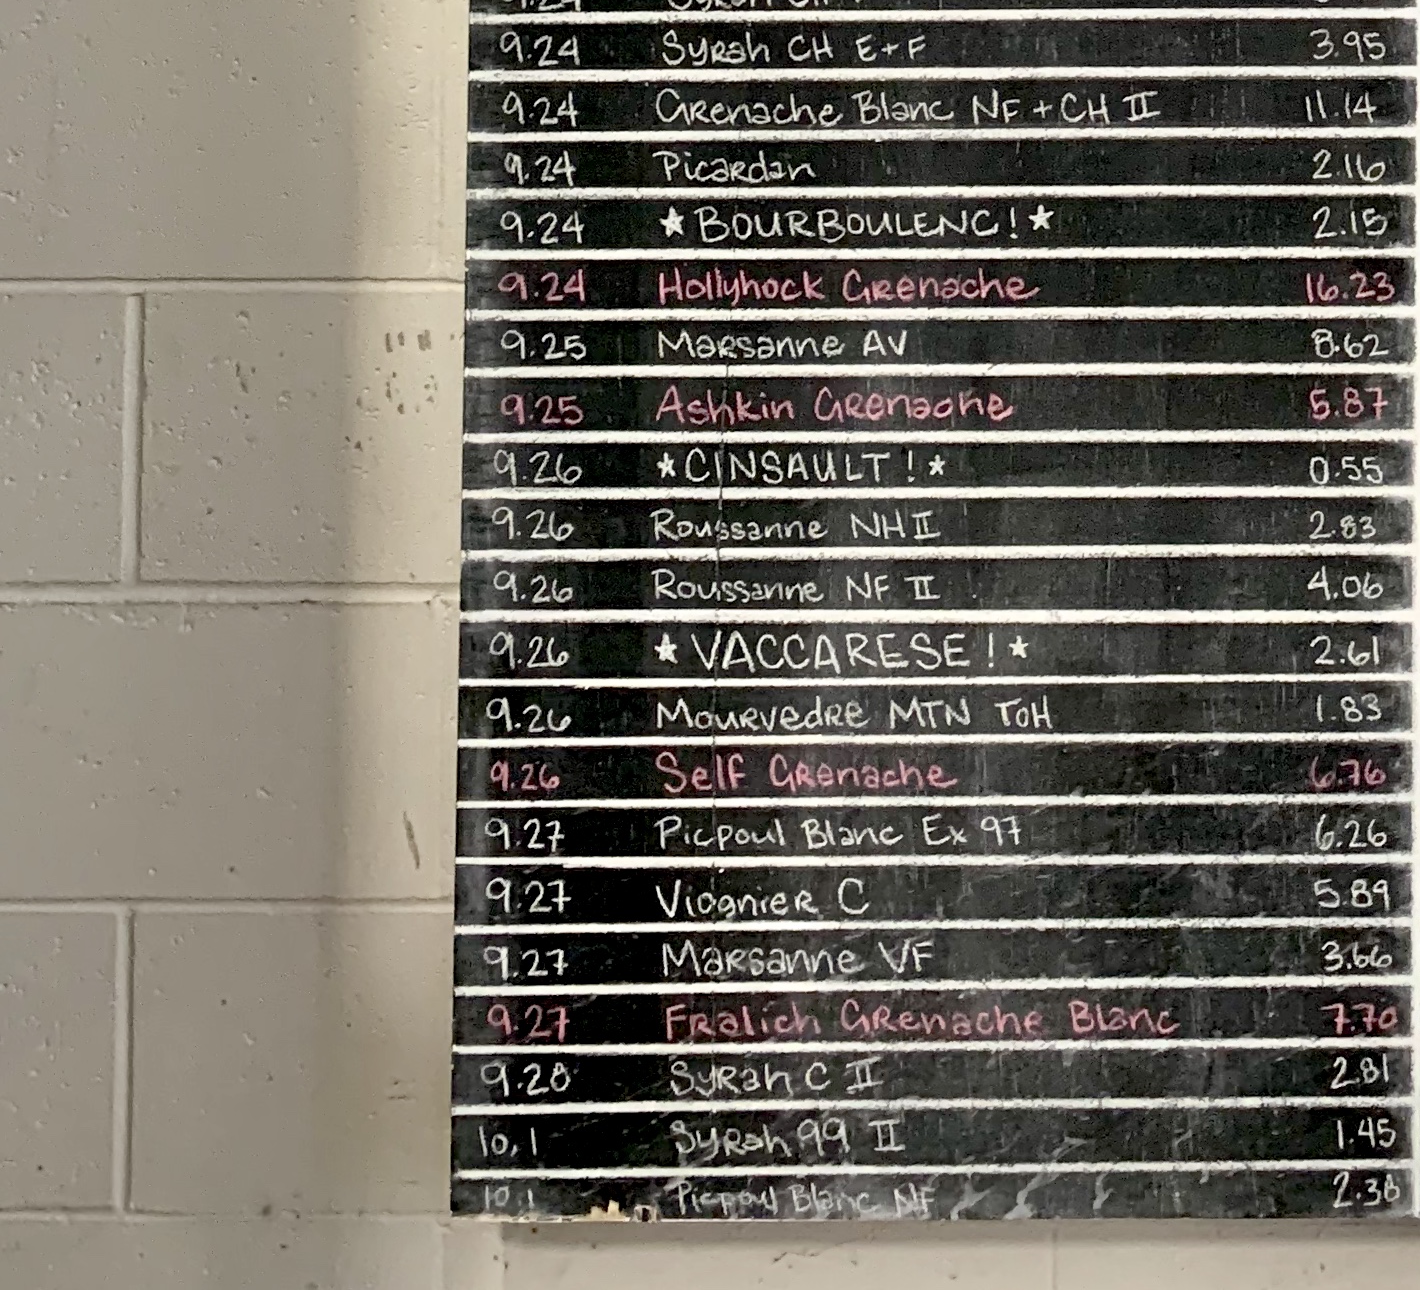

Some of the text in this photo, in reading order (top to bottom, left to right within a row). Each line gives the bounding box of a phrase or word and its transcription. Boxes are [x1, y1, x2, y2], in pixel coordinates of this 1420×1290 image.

[501, 211, 584, 244] 9.24
[1313, 206, 1387, 239] 2.15
[498, 269, 585, 301] 9.24
[659, 268, 824, 306] Hollyhock
[1307, 272, 1394, 302] 16.23
[651, 569, 823, 603] Roussanne
[846, 572, 889, 601] NF
[905, 576, 940, 600] II
[1308, 567, 1383, 600] 4.06
[485, 814, 1387, 852] 9.27 Picpoul Blanc Ex 97 6.26
[487, 877, 571, 913] 9.27
[838, 878, 869, 914] C
[1314, 879, 1389, 910] 5.89
